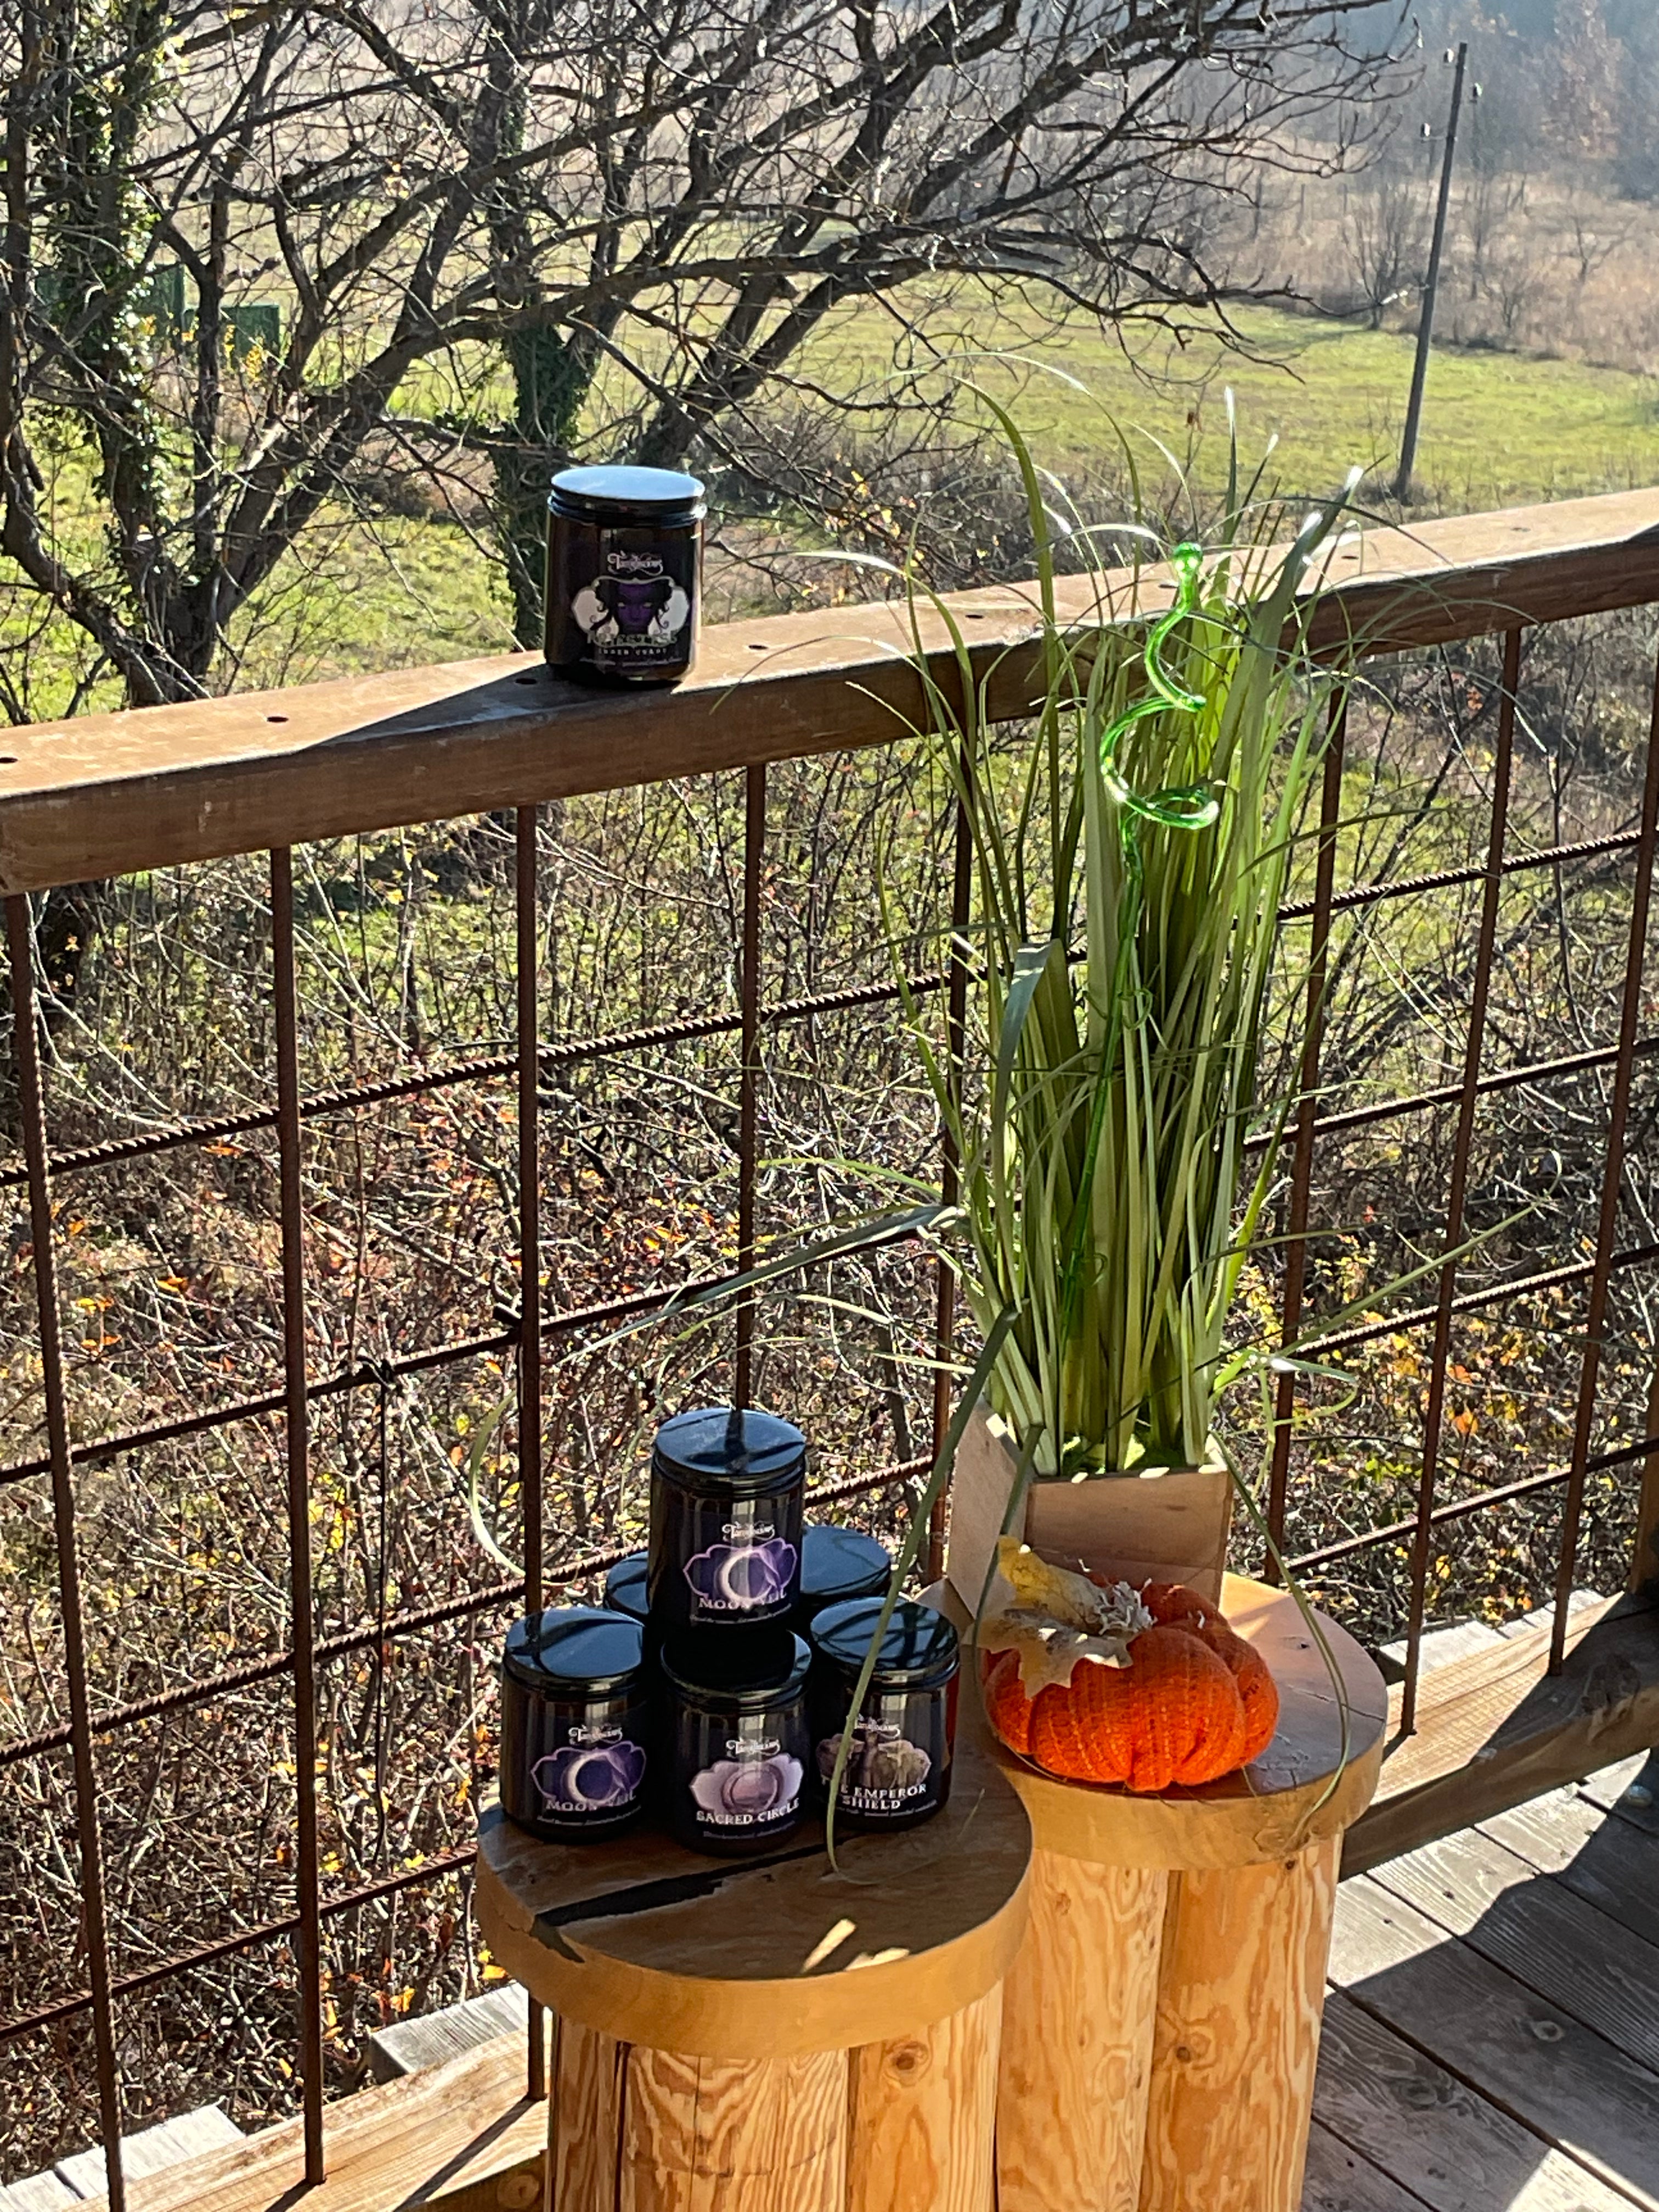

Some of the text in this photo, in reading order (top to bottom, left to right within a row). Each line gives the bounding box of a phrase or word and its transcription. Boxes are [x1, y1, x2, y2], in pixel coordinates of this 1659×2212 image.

[854, 1784, 927, 1799] EMPEROR
[842, 1795, 901, 1810] SHIELD
[696, 1798, 799, 1825] SACRED CIRCLE
